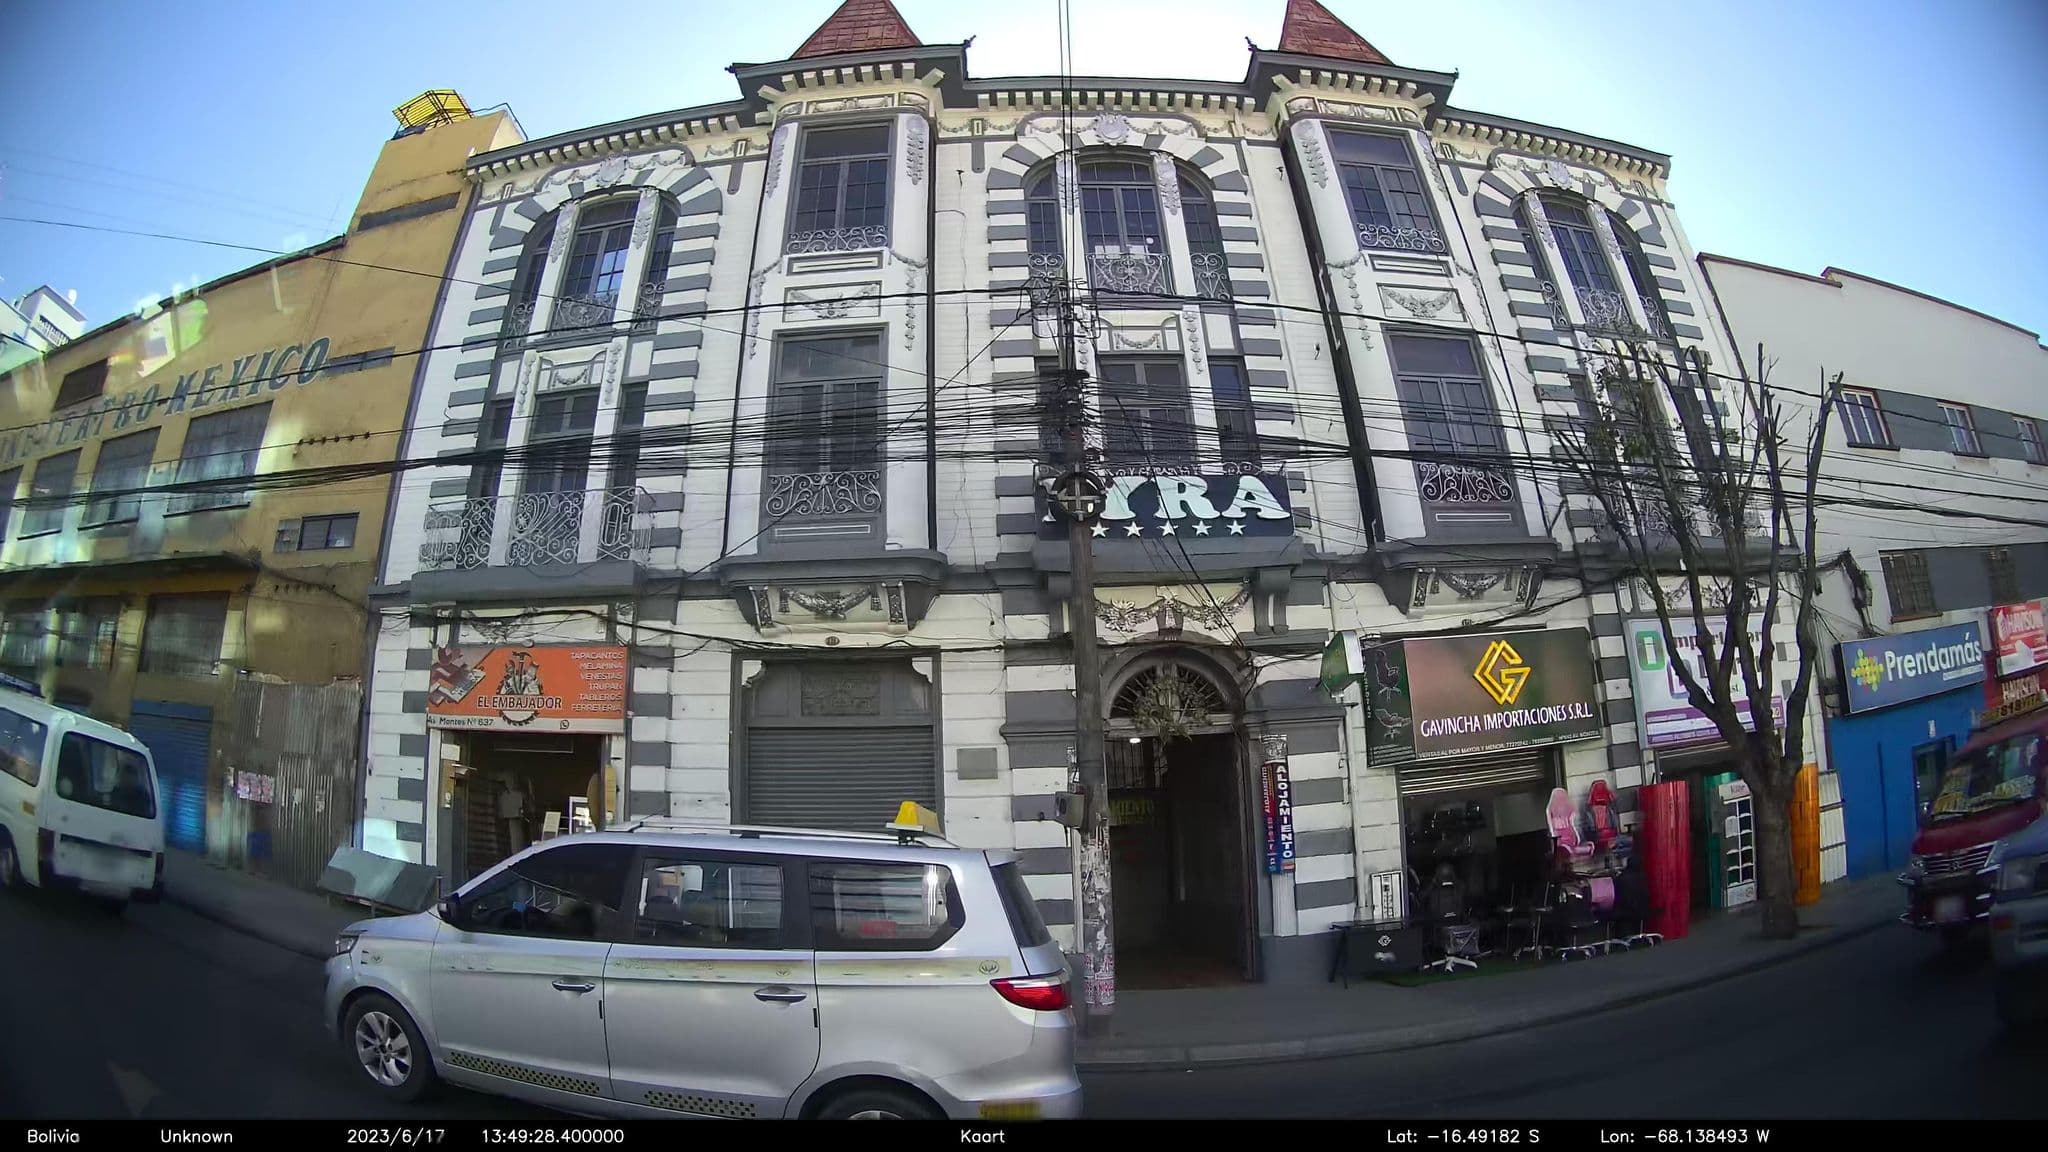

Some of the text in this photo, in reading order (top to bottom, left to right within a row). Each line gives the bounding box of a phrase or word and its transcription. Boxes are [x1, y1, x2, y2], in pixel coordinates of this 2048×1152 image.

[164, 336, 331, 415] MEXICO
[1885, 632, 1983, 682] Prendamás
[477, 696, 562, 709] EL EMBAJADOR
[579, 693, 622, 701] TABLEROS
[440, 717, 465, 726] Montes
[1421, 715, 1482, 737] GAVINCHA
[1485, 705, 1567, 730] IMPORTACIONES
[1276, 765, 1294, 858] ALOJAMIENTO
